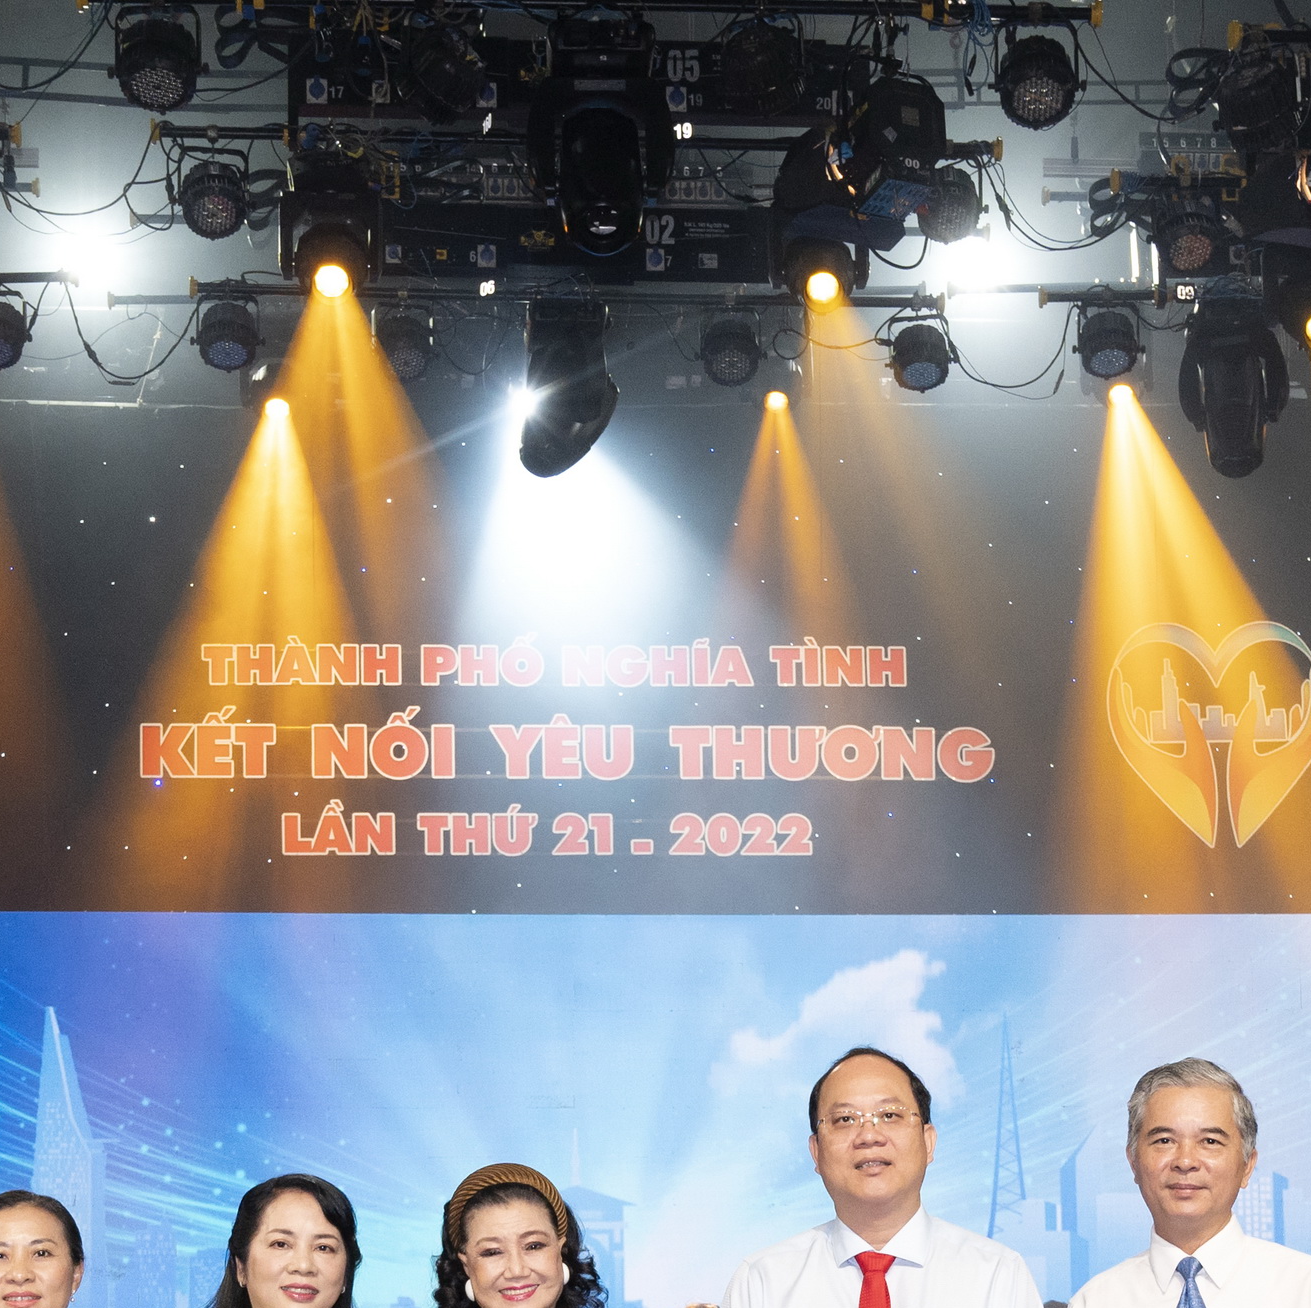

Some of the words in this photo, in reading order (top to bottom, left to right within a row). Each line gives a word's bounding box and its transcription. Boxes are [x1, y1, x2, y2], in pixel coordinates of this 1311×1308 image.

[667, 49, 700, 82] 05
[329, 85, 344, 99] 17
[688, 94, 703, 107] 19
[816, 97, 832, 110] 20
[673, 122, 693, 140] 19
[645, 215, 675, 245] 02
[470, 251, 477, 262] 6
[665, 255, 673, 267] 7
[480, 280, 495, 296] 06
[1177, 285, 1195, 300] 09
[201, 635, 402, 686] THÀNH
[420, 632, 545, 687] PHỐ
[561, 637, 755, 687] NGHĨA
[769, 636, 907, 687] TÌNH
[140, 705, 276, 778] KẾT
[311, 705, 456, 780] NỐI
[489, 713, 634, 780] YÊU
[669, 724, 995, 783] THƯƠNG
[281, 799, 396, 856] LẦN
[416, 804, 538, 856] THỨ
[552, 813, 614, 856] 21
[669, 813, 813, 856] 2022
